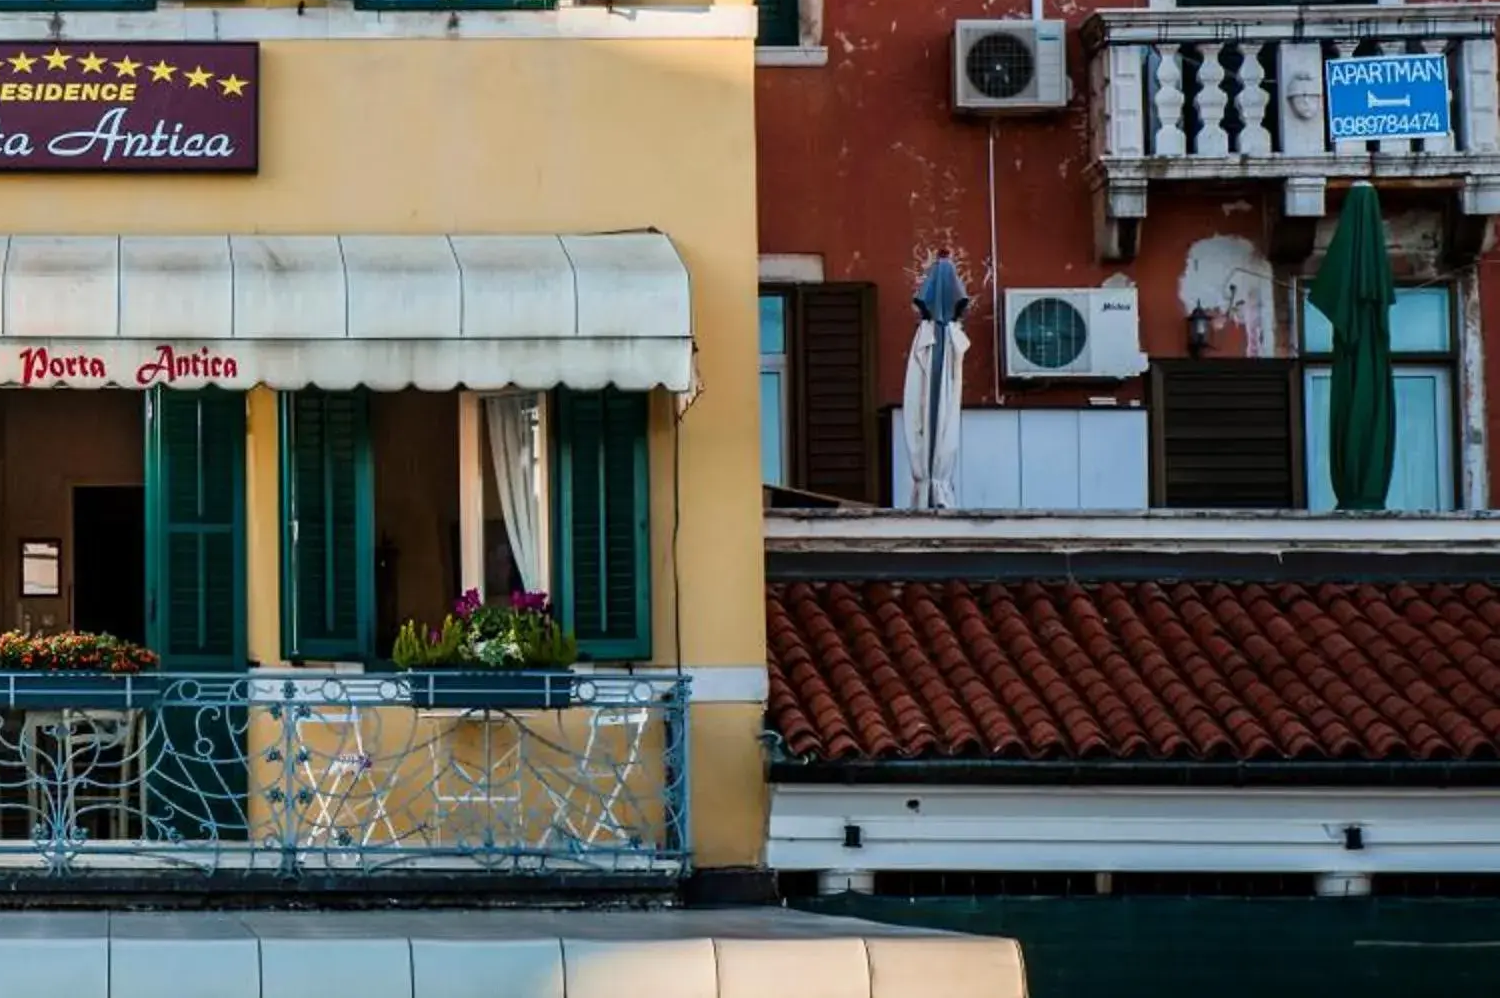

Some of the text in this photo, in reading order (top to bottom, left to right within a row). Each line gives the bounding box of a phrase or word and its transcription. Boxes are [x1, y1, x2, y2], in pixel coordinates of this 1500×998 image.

[1331, 60, 1443, 86] APARTMAN
[47, 107, 234, 162] Antica
[1332, 112, 1440, 135] 0989784474
[19, 346, 106, 385] Porta
[136, 345, 238, 385] Antica
